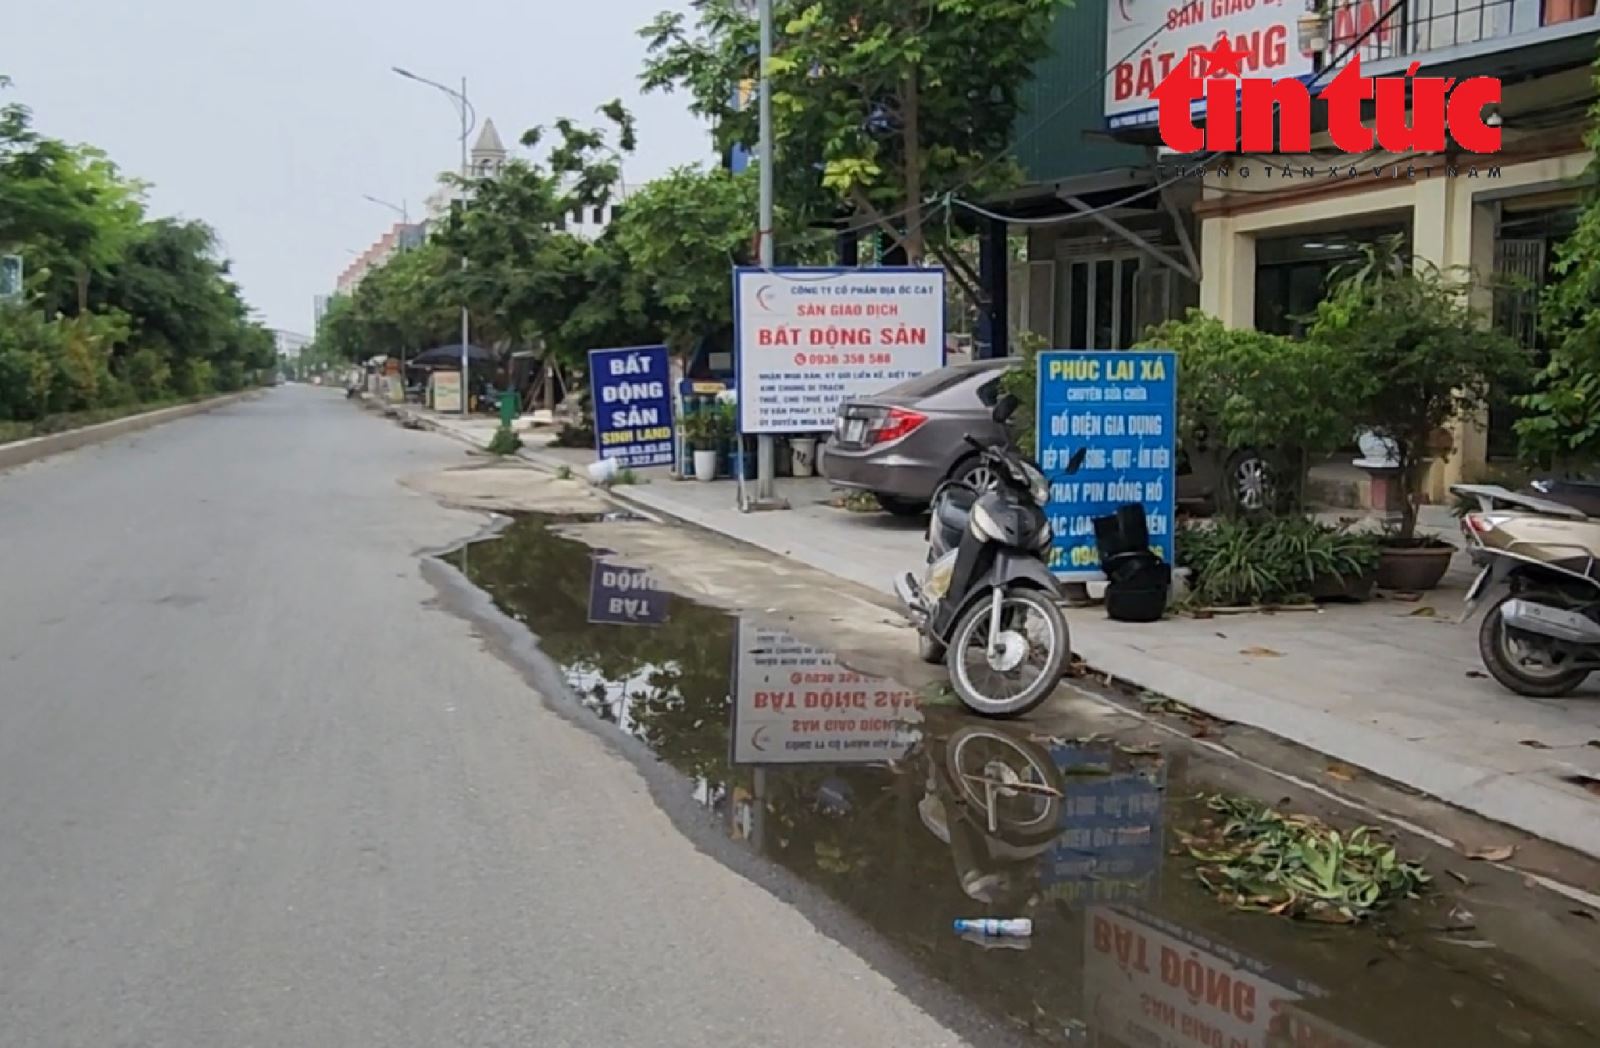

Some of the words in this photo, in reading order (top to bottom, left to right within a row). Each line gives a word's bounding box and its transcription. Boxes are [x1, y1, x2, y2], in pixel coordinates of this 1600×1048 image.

[831, 304, 862, 317] GIAO
[866, 304, 898, 319] DỊCH
[759, 322, 801, 346] BẤT
[810, 325, 872, 349] ĐỘNG
[880, 322, 927, 346] SẢN
[610, 352, 652, 376] BẤT
[1049, 355, 1100, 381] PHÚC
[1106, 359, 1134, 381] LAI
[1140, 355, 1166, 381] XÁ
[603, 381, 664, 405] ĐỘNG
[612, 405, 658, 428] SẢN
[1104, 415, 1125, 436] GIA
[1128, 415, 1162, 440] DỤNG
[637, 426, 671, 441] LAND
[1083, 482, 1104, 503] PIN
